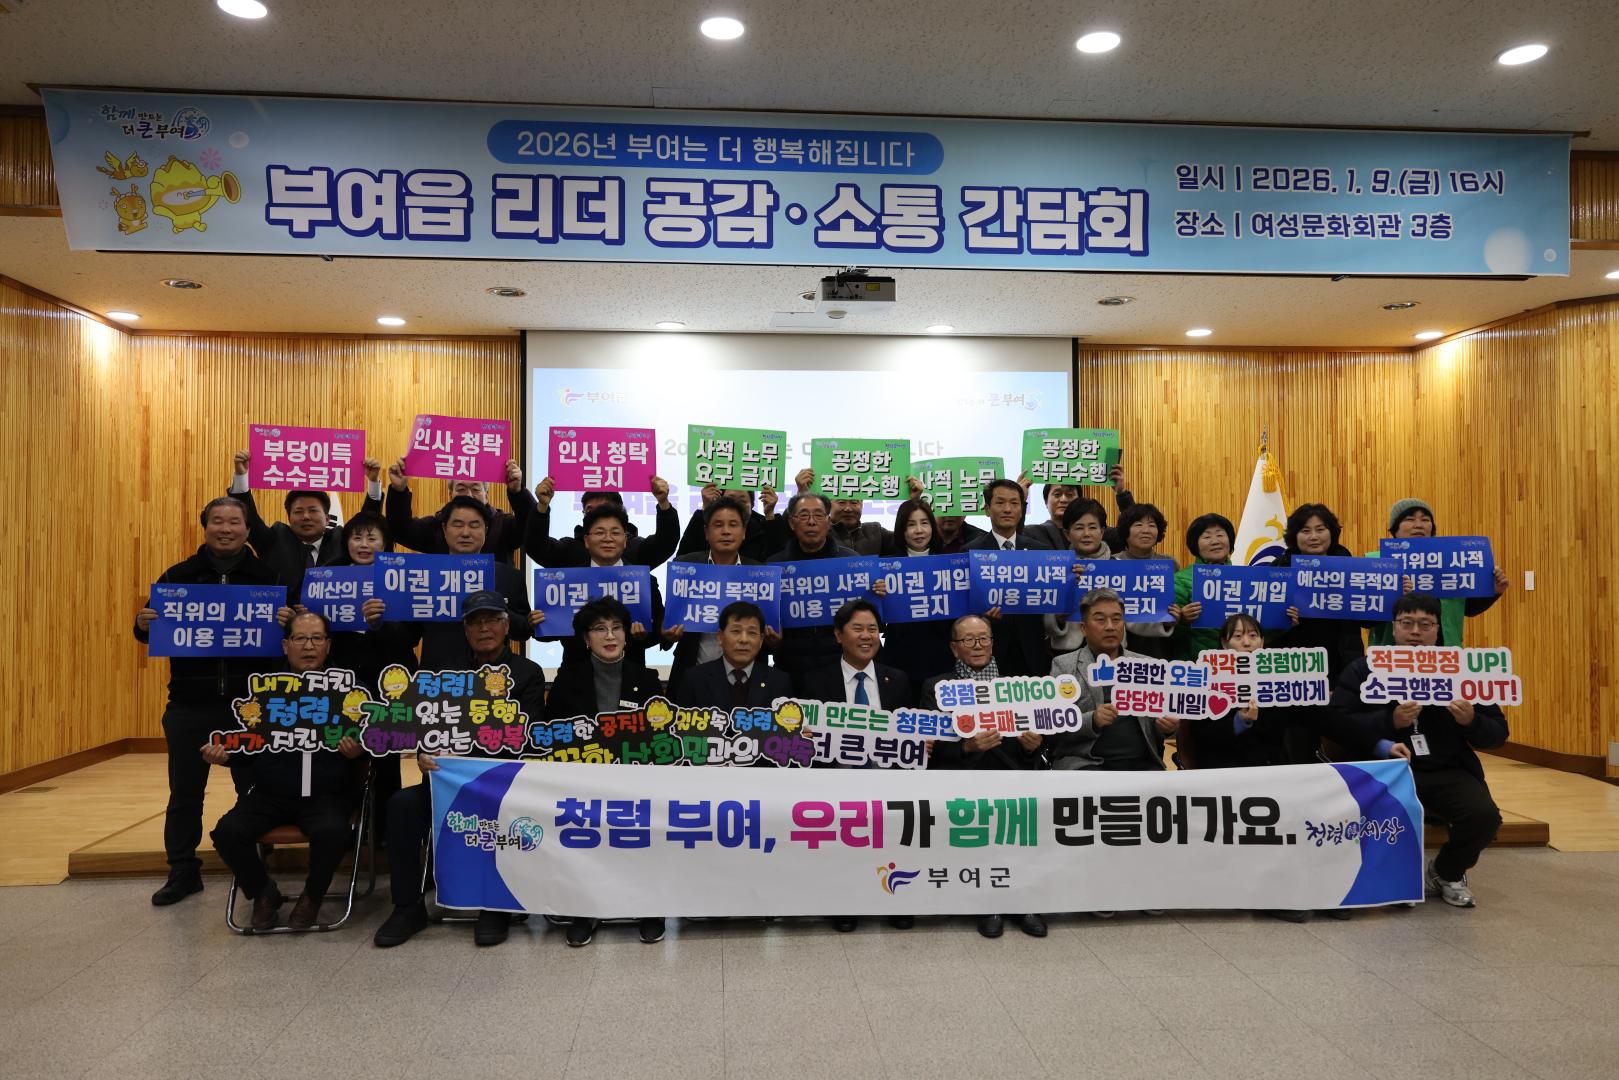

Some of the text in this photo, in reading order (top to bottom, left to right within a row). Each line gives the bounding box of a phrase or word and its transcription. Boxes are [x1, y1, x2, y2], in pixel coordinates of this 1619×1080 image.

[517, 130, 916, 168] 2026년 부여는 더 행복해집니다
[1175, 164, 1225, 191] 일시
[1252, 167, 1338, 193] 2026.
[1449, 170, 1505, 196] 16시
[267, 165, 472, 241] 부여읍
[493, 173, 626, 245] 리더
[961, 184, 1149, 256] 간담회
[1175, 211, 1225, 238] 장소
[1252, 212, 1402, 239] 여성문화회관
[1410, 214, 1453, 241] 3층
[264, 440, 352, 465] 부당이득
[414, 428, 503, 456] 인사 청탁
[558, 441, 600, 464] 인사
[607, 442, 649, 465] 청탁
[696, 438, 735, 462] 사적
[742, 441, 779, 464] 노무
[1042, 438, 1100, 460] 공정한
[435, 454, 476, 478] 금지
[832, 450, 892, 473] 공정한
[1032, 460, 1107, 482] 직무수행
[263, 464, 351, 488] 수수금지
[582, 466, 623, 488] 금지
[695, 462, 778, 488] 요구 금지
[821, 474, 900, 497] 직무수행
[1450, 551, 1484, 568] 사적
[385, 568, 430, 593] 이권
[440, 569, 484, 593] 개입
[780, 572, 870, 596] 직위의 사적
[885, 568, 970, 595] 이권 개입
[980, 565, 1067, 584] 직위의 사적
[1133, 575, 1165, 592] 사적
[1297, 570, 1398, 591] 예산의 목적외
[1441, 572, 1475, 590] 금지
[308, 581, 357, 599] 예산의
[545, 583, 588, 606] 이권
[672, 578, 775, 601] 예산의 목적외
[988, 588, 1058, 606] 이용 금지
[1203, 579, 1287, 603] 이권 개입
[163, 602, 273, 623] 직위의 사적
[412, 595, 456, 618] 금지
[684, 604, 719, 624] 사용
[789, 599, 823, 618] 이용
[910, 594, 949, 618] 금지
[1124, 597, 1156, 615] 금지
[1309, 593, 1384, 612] 사용 금지
[173, 627, 262, 648] 이용 금지
[1117, 661, 1207, 687] 청렴한 오늘!
[1255, 651, 1324, 675] 청렴하게
[1372, 650, 1507, 674] 적극행정 UP!
[252, 671, 351, 693] 내가 지킨
[416, 673, 474, 697] 청렴!
[940, 680, 1056, 706] 청렴은 더하GO
[1256, 679, 1325, 702] 공정하게
[1365, 677, 1518, 701] 소극행정 OUT!
[266, 696, 340, 726] 청렴,
[363, 700, 526, 724] 가치 있는 동행,
[1115, 689, 1206, 715] 당당한 내일!
[826, 706, 889, 731] 만드는
[980, 708, 1078, 732] 부패는 빼GO
[271, 728, 317, 749] 지킨
[364, 725, 525, 752] 함께 여는 행복
[533, 720, 594, 746] 청렴한
[764, 735, 815, 767] 약속
[840, 734, 865, 761] 큰
[873, 737, 926, 766] 부여
[447, 812, 477, 832] 함께
[554, 795, 1296, 853] 청렴 부여, 우리가 함께 만들어가요.
[928, 867, 1010, 889] 부여군
